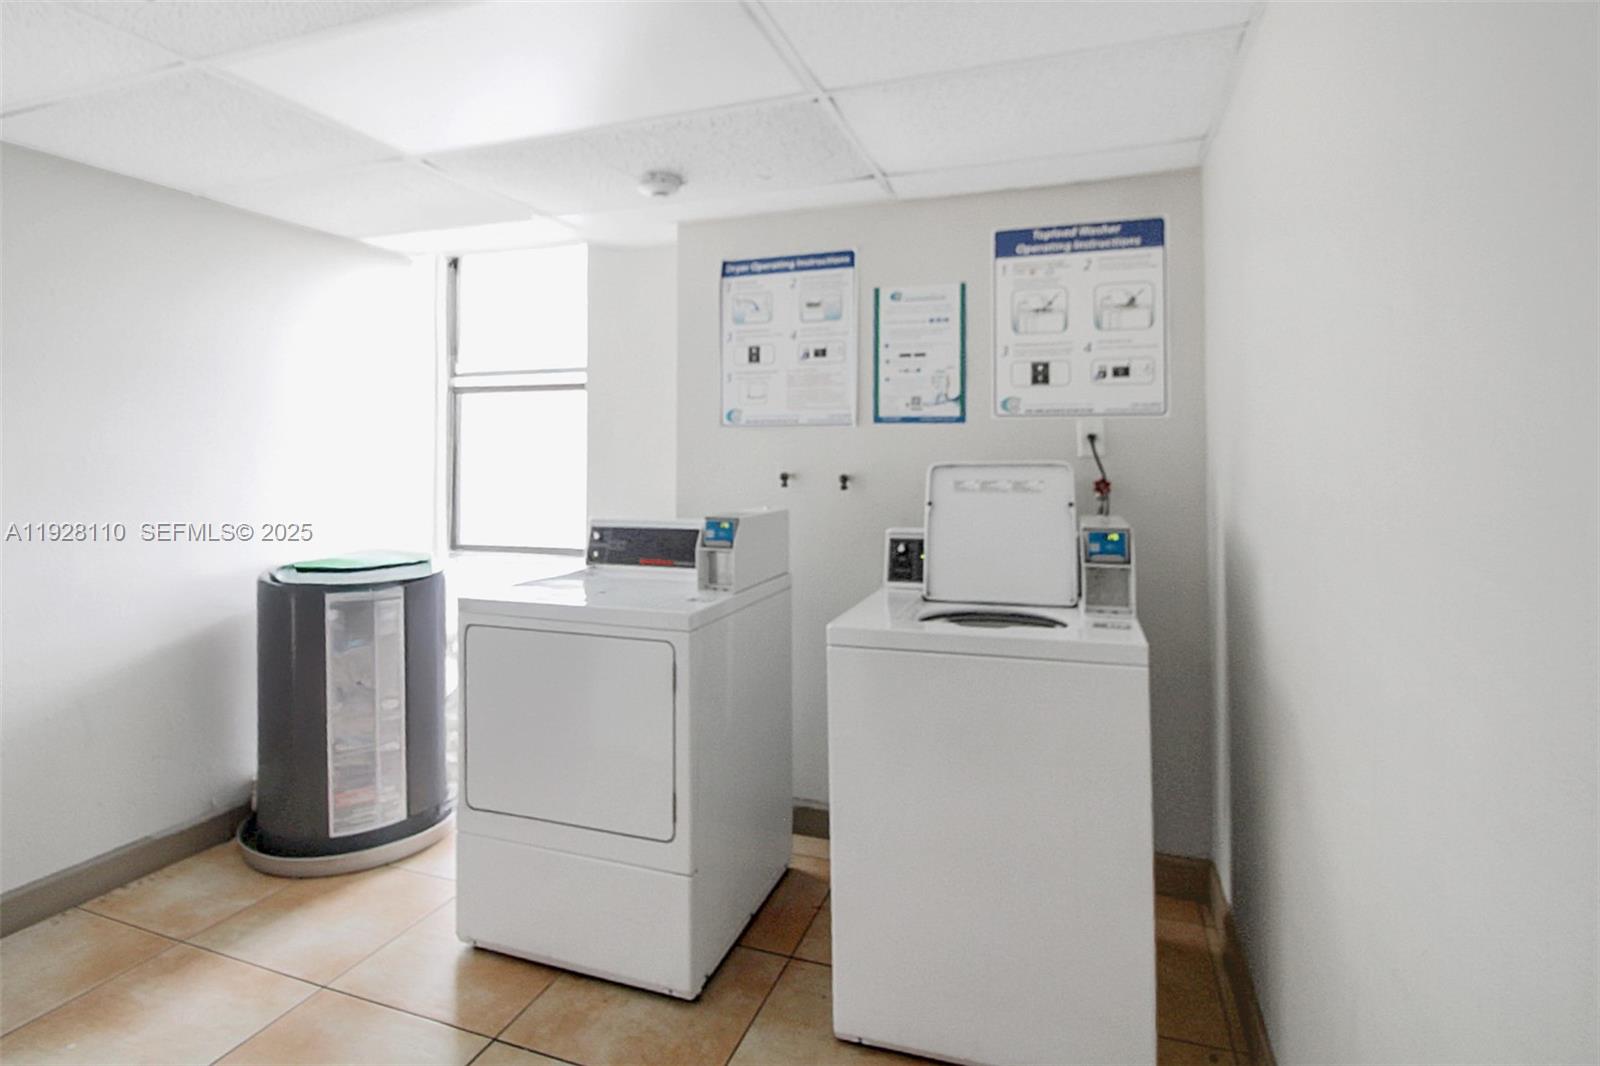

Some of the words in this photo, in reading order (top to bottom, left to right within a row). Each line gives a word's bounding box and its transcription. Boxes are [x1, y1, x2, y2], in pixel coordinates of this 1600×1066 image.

[1015, 241, 1072, 255] Operating
[1073, 236, 1142, 250] Instructions
[750, 260, 795, 273] Operating
[796, 254, 850, 268] Instructions
